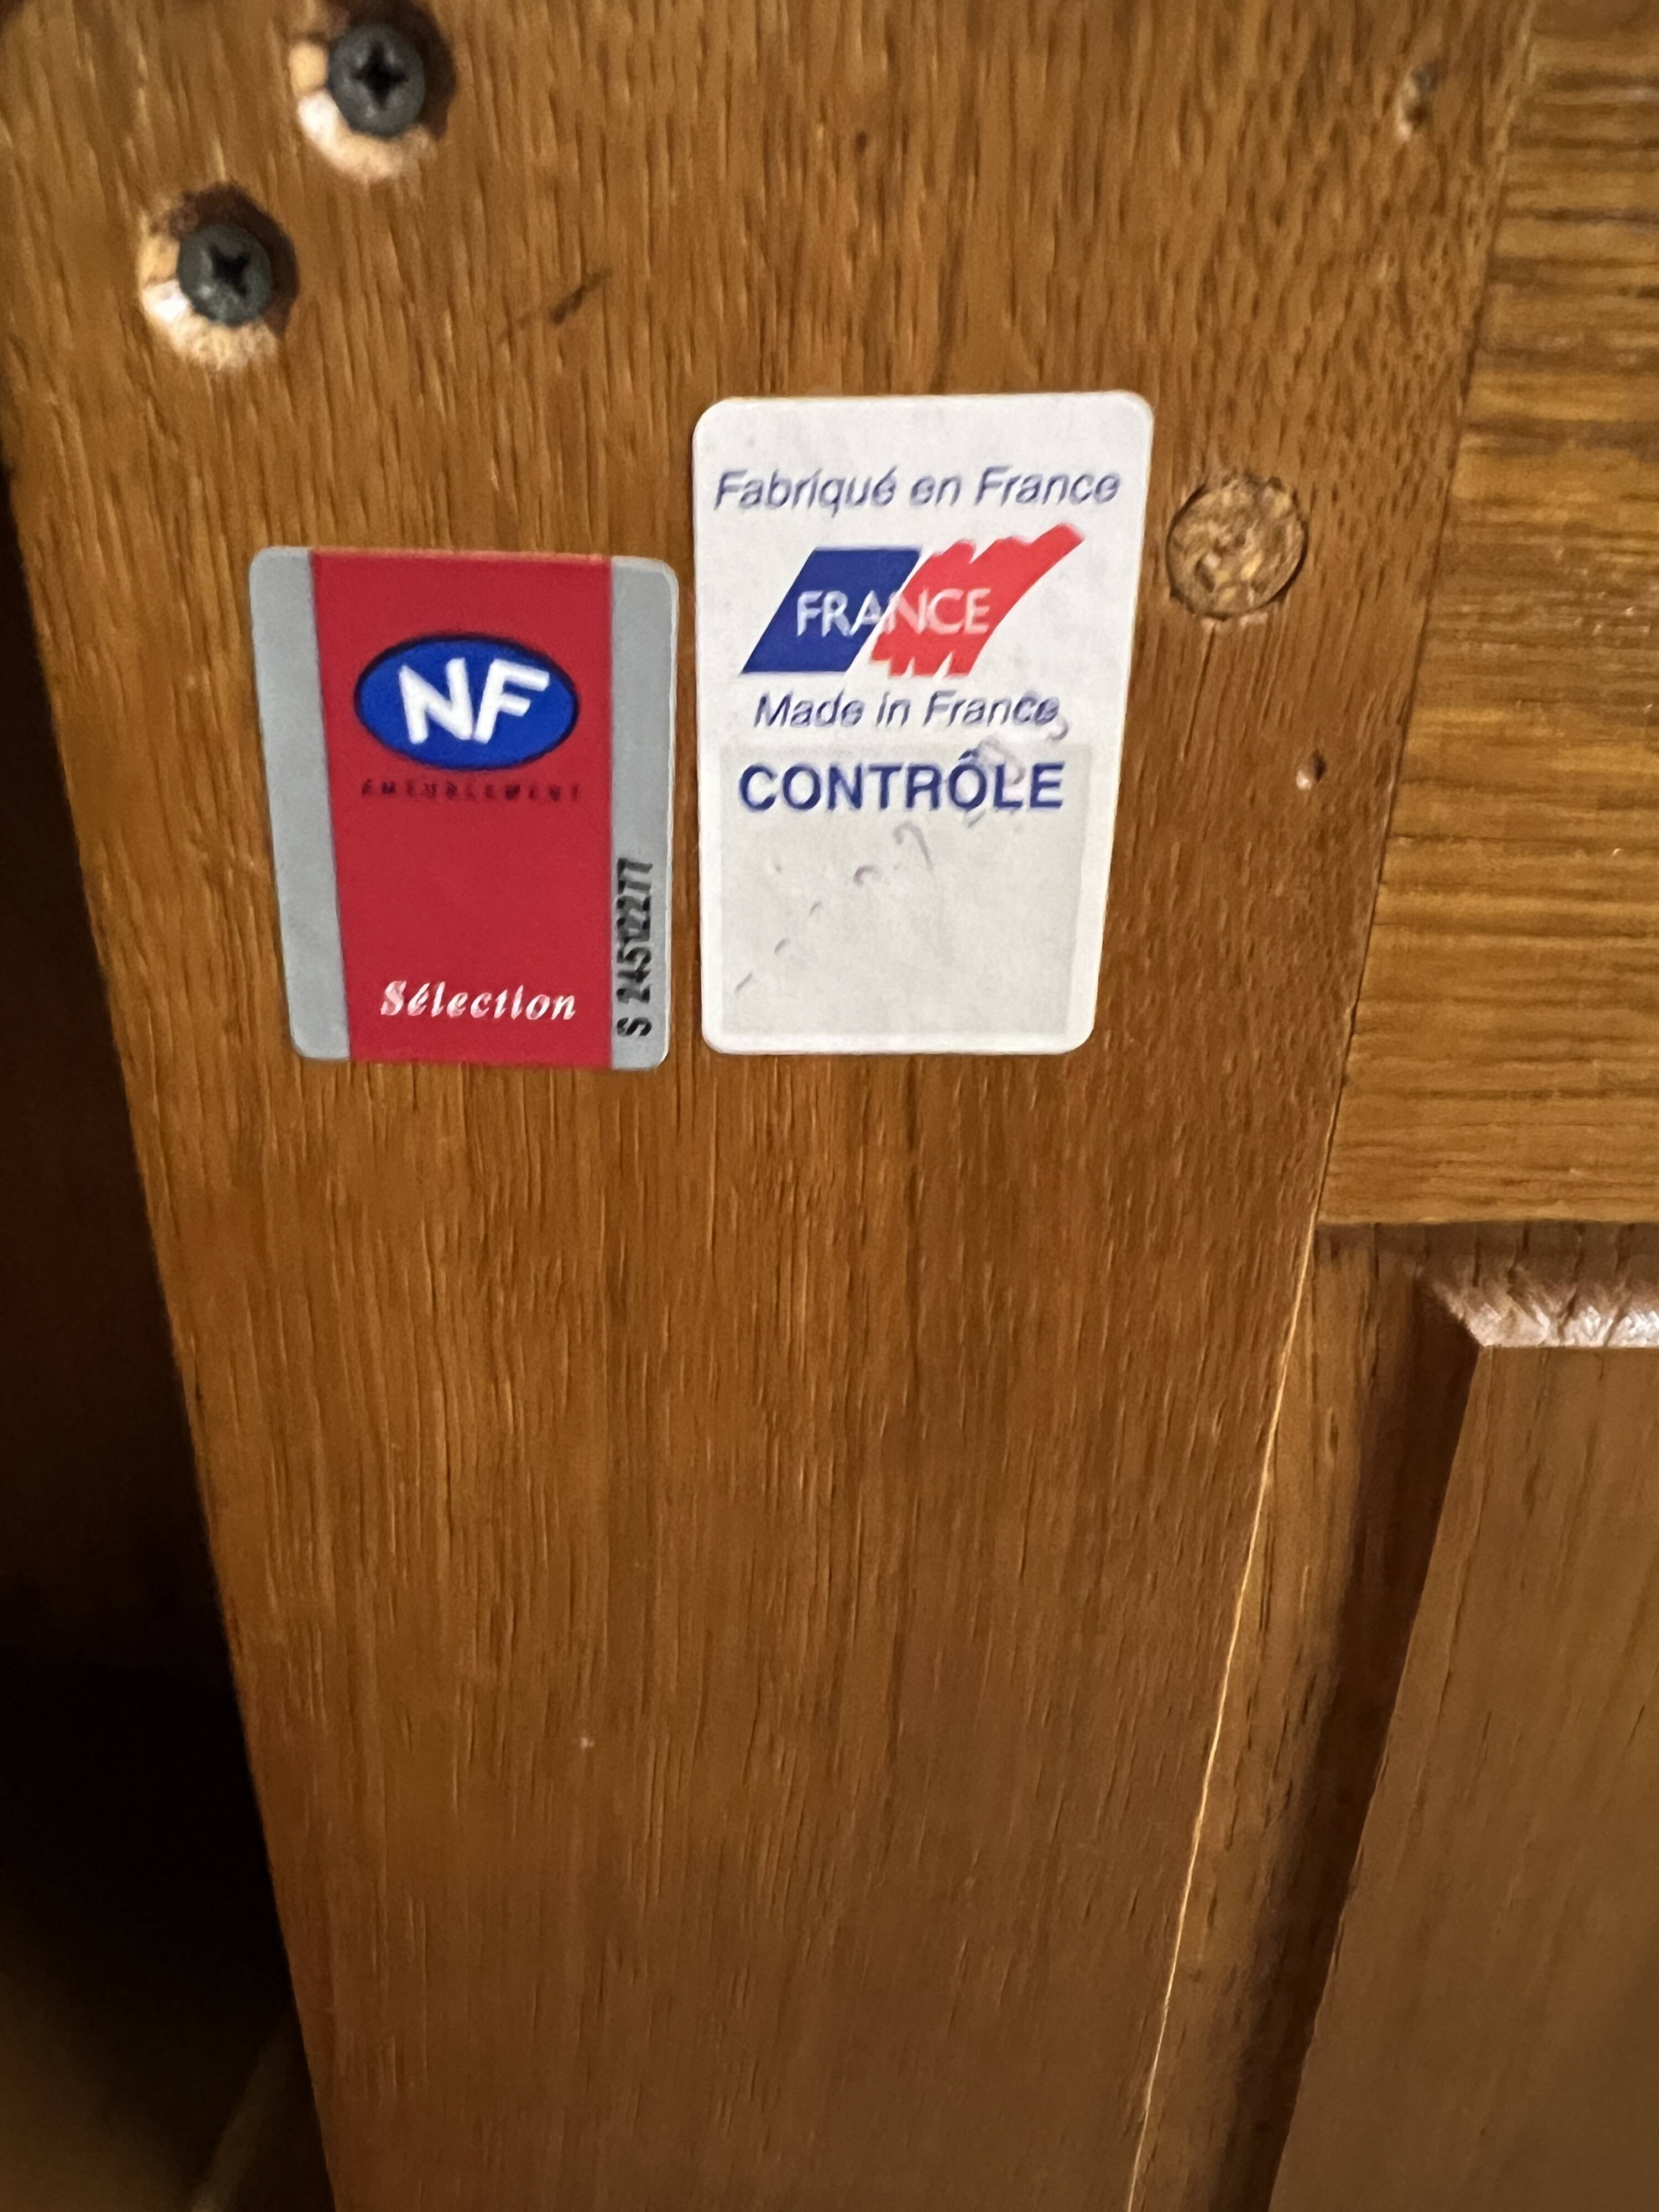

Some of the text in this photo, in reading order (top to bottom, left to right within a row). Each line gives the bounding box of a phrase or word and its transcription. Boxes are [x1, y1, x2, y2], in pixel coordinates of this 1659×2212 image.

[713, 465, 1121, 517] Fabriqué en France
[796, 588, 992, 638] FRANCE
[398, 657, 550, 744] NF
[754, 691, 1060, 728] Made in France
[739, 748, 1066, 812] CONTRÔLE
[380, 980, 576, 1020] Sélection
[616, 1016, 653, 1037] S
